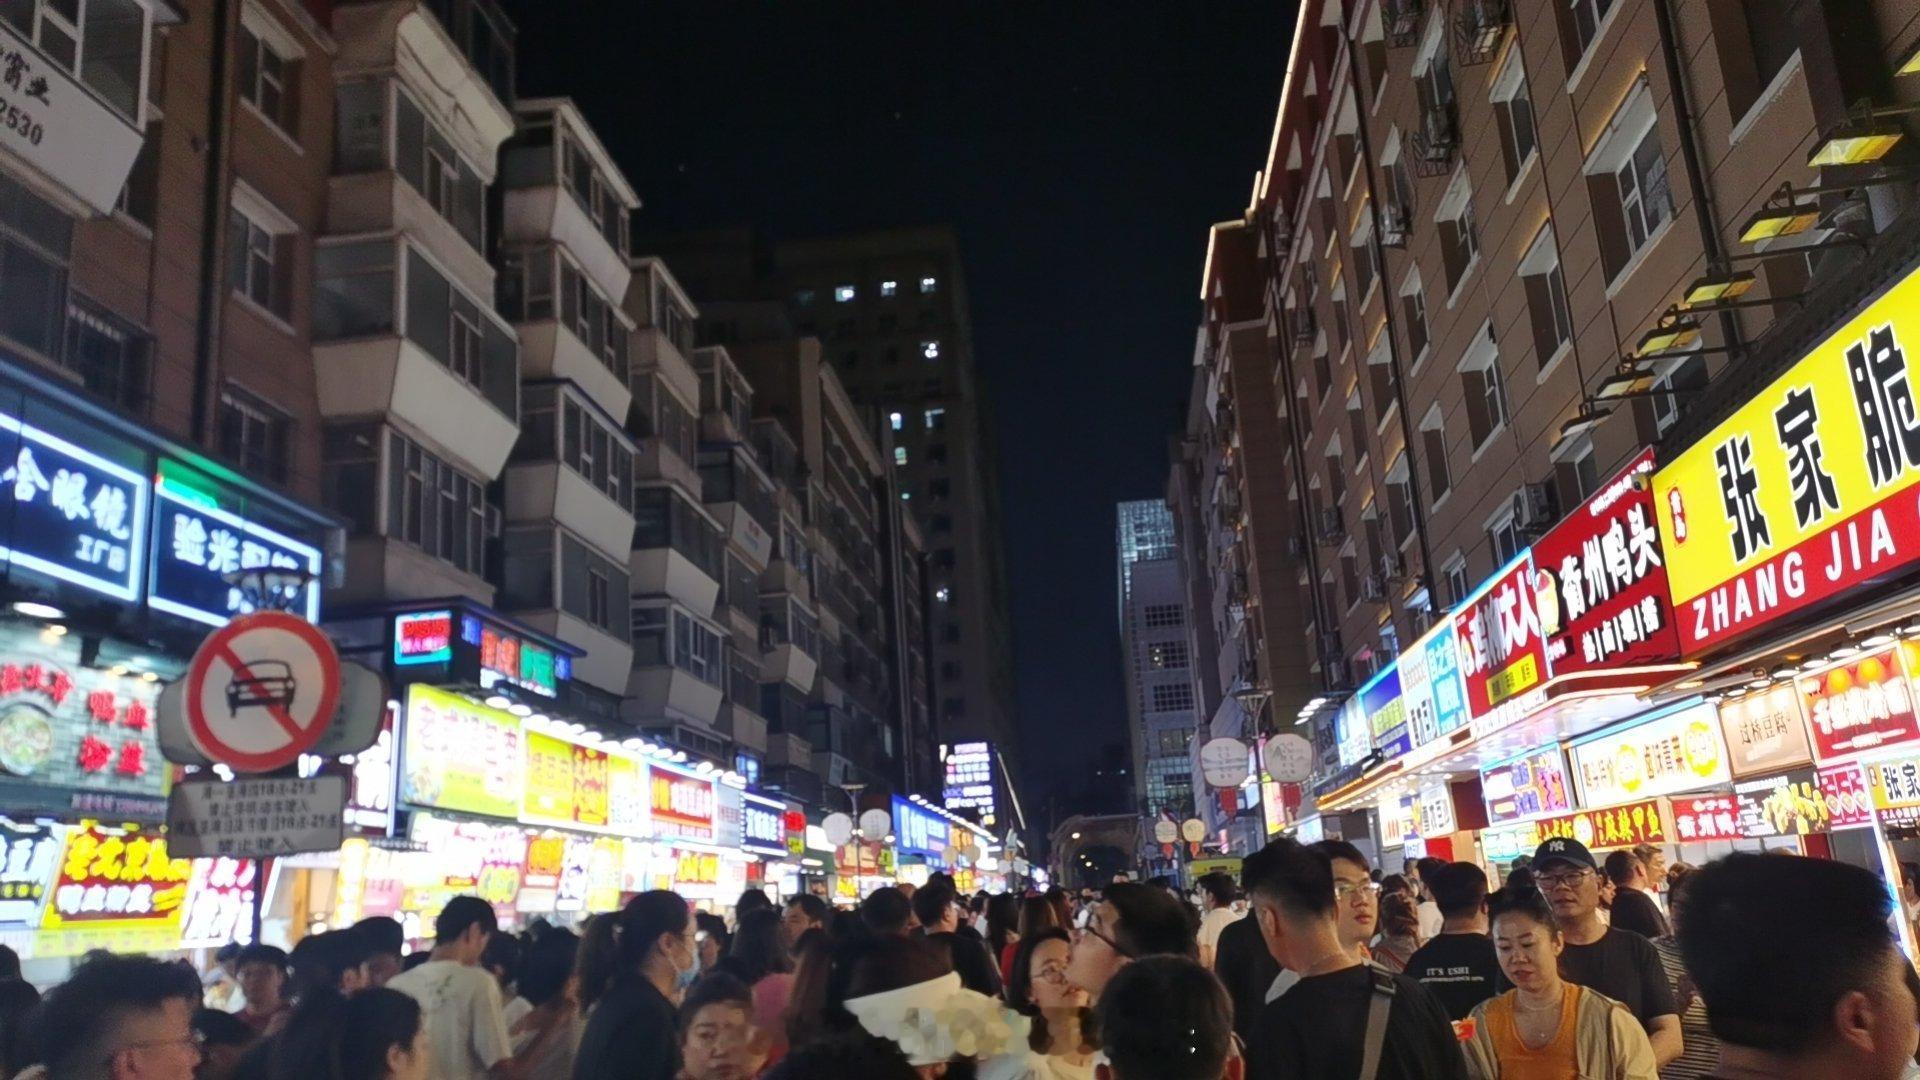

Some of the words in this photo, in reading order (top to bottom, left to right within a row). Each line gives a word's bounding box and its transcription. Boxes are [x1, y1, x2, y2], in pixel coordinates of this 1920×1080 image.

[1693, 550, 1806, 641] ZHANG
[1825, 508, 1896, 582] JIA
[1676, 813, 1743, 839] 衢州鸭
